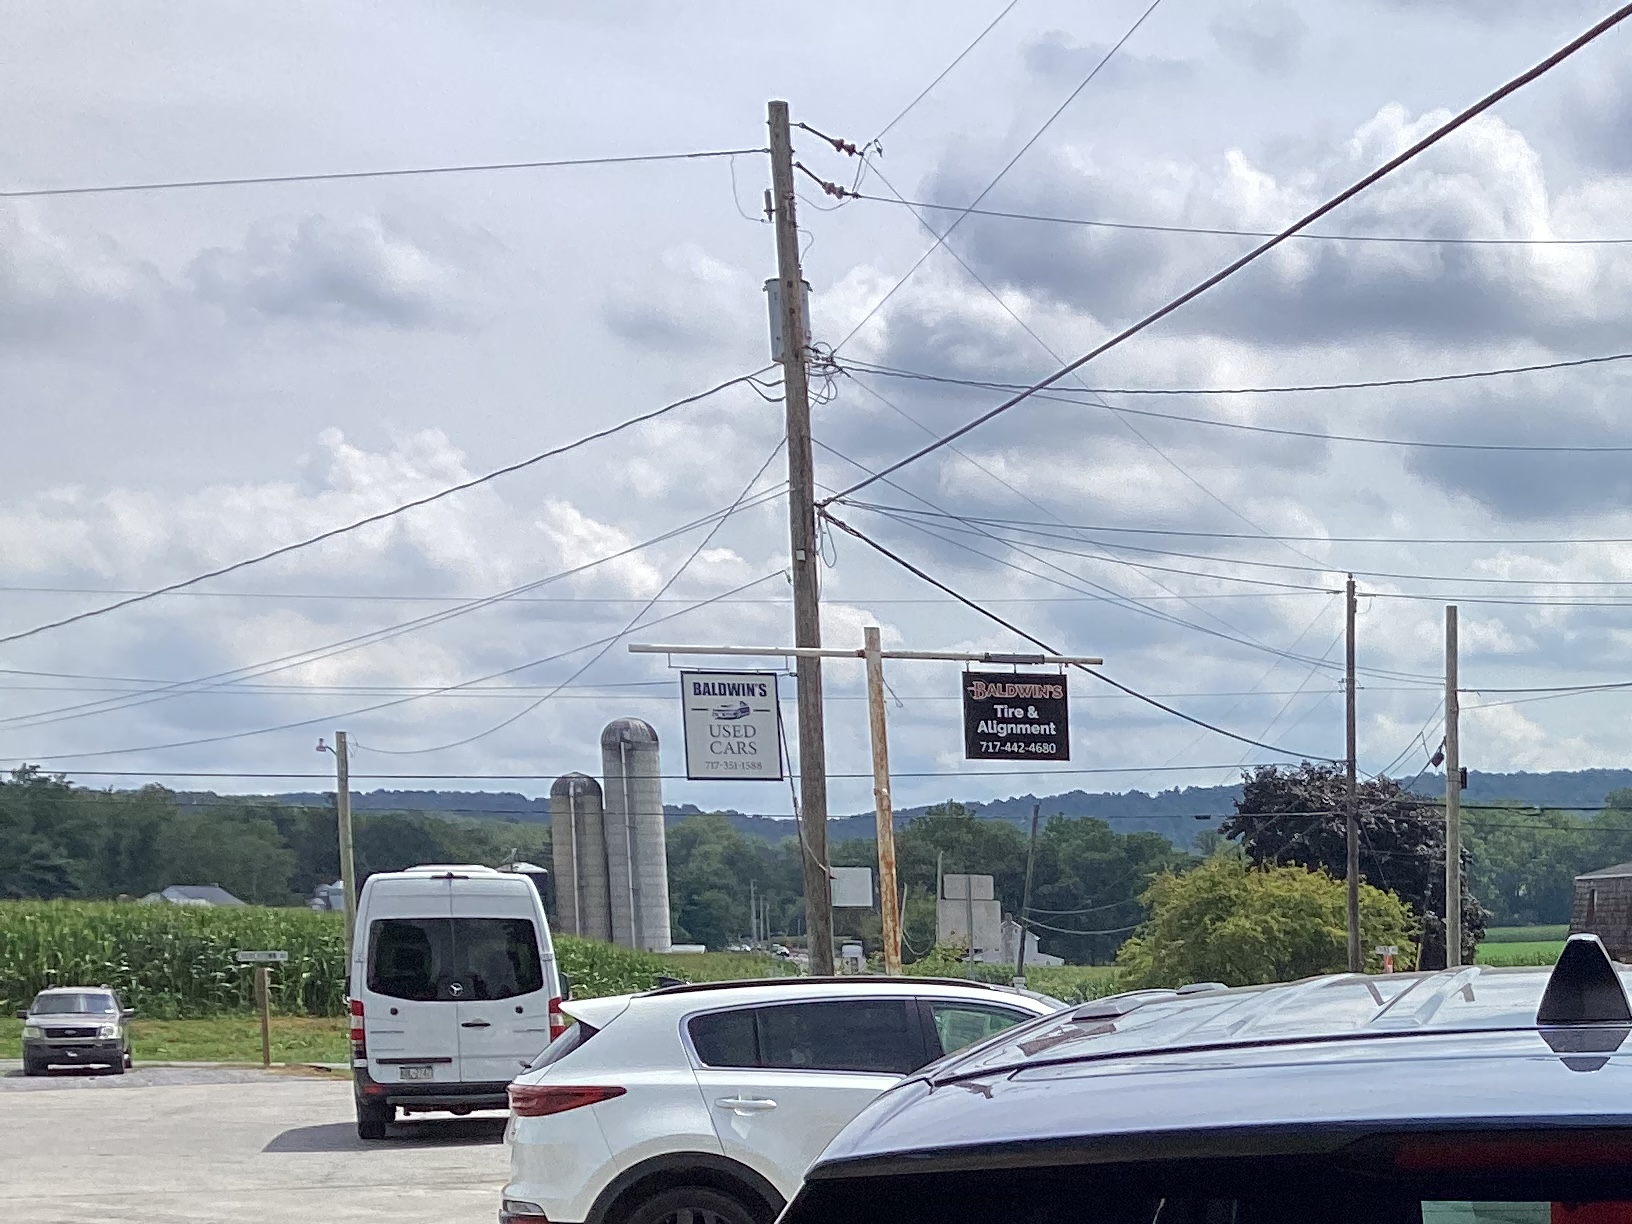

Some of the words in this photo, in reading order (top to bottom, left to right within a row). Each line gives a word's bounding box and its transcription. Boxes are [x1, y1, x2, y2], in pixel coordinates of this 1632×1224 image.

[693, 682, 767, 697] BALDWIN'S
[966, 680, 1064, 700] BALDWIN'S
[993, 705, 1024, 718] Tire
[1027, 705, 1039, 719] &
[709, 724, 757, 739] USED
[977, 720, 1057, 737] Alignment
[710, 741, 758, 755] CARS
[980, 741, 1057, 754] 717-442-4680
